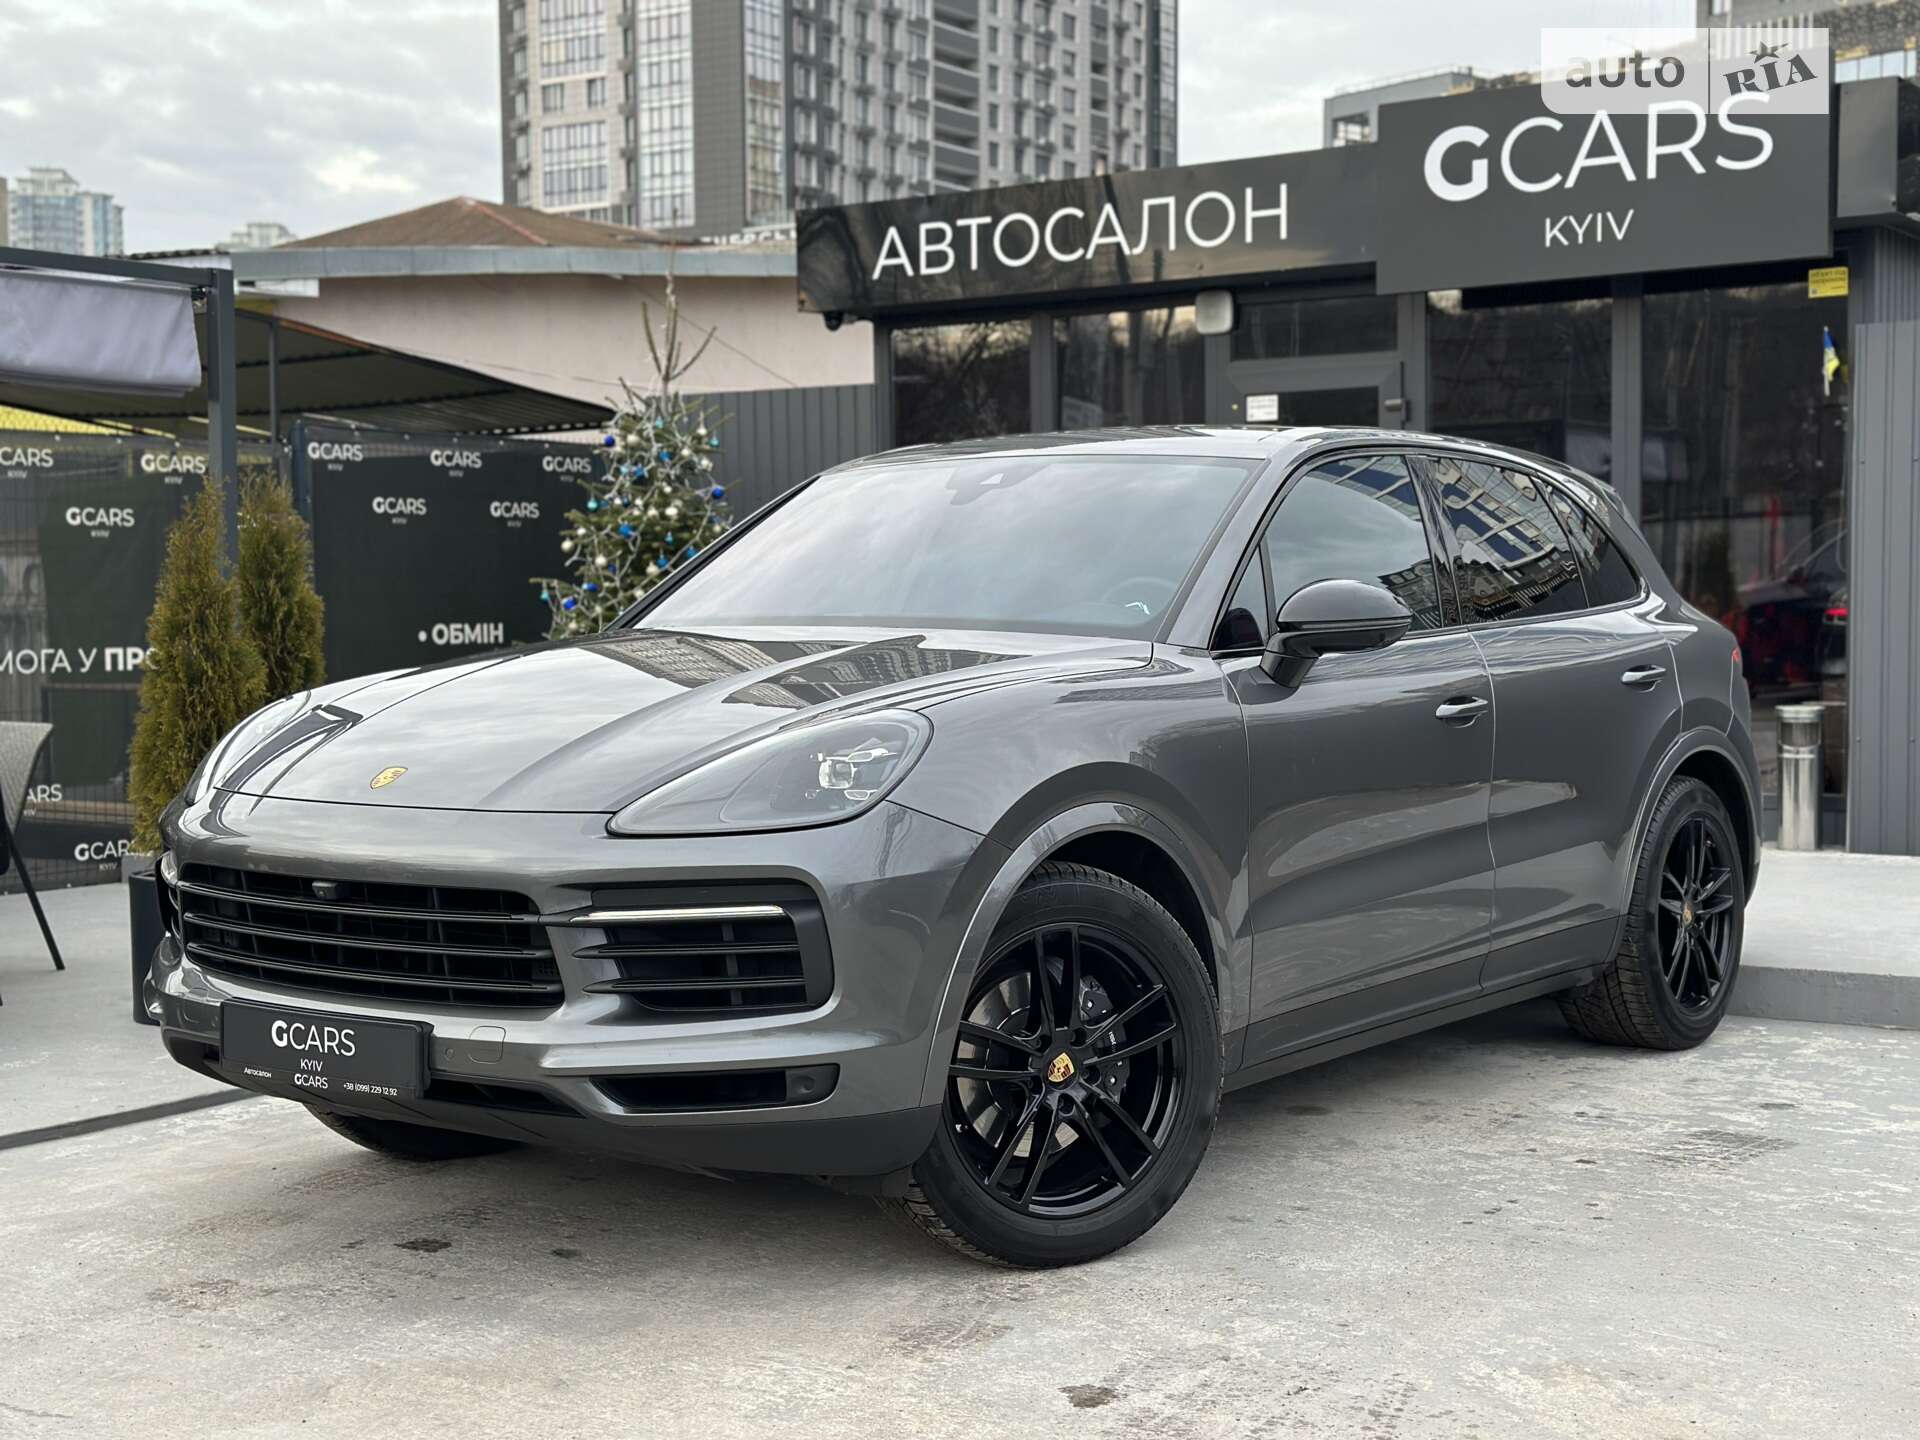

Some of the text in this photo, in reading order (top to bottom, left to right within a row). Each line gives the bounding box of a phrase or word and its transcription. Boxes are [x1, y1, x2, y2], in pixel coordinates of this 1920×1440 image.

[1424, 91, 1774, 202] GCARS
[872, 182, 1289, 281] АВТОСАЛОН
[1545, 209, 1635, 248] KYIV
[307, 441, 363, 462] GCARS
[430, 450, 482, 469] GCARS
[140, 453, 206, 474] GCARS
[542, 455, 592, 474] GCARS
[372, 496, 427, 515] GCARS
[490, 501, 541, 519] GCARS
[65, 506, 135, 527] GCARS
[431, 622, 504, 645] ОБМІН
[78, 647, 98, 673] У
[271, 1019, 356, 1056] GCARS
[300, 1058, 323, 1072] KYIV
[294, 1073, 329, 1089] GCARS
